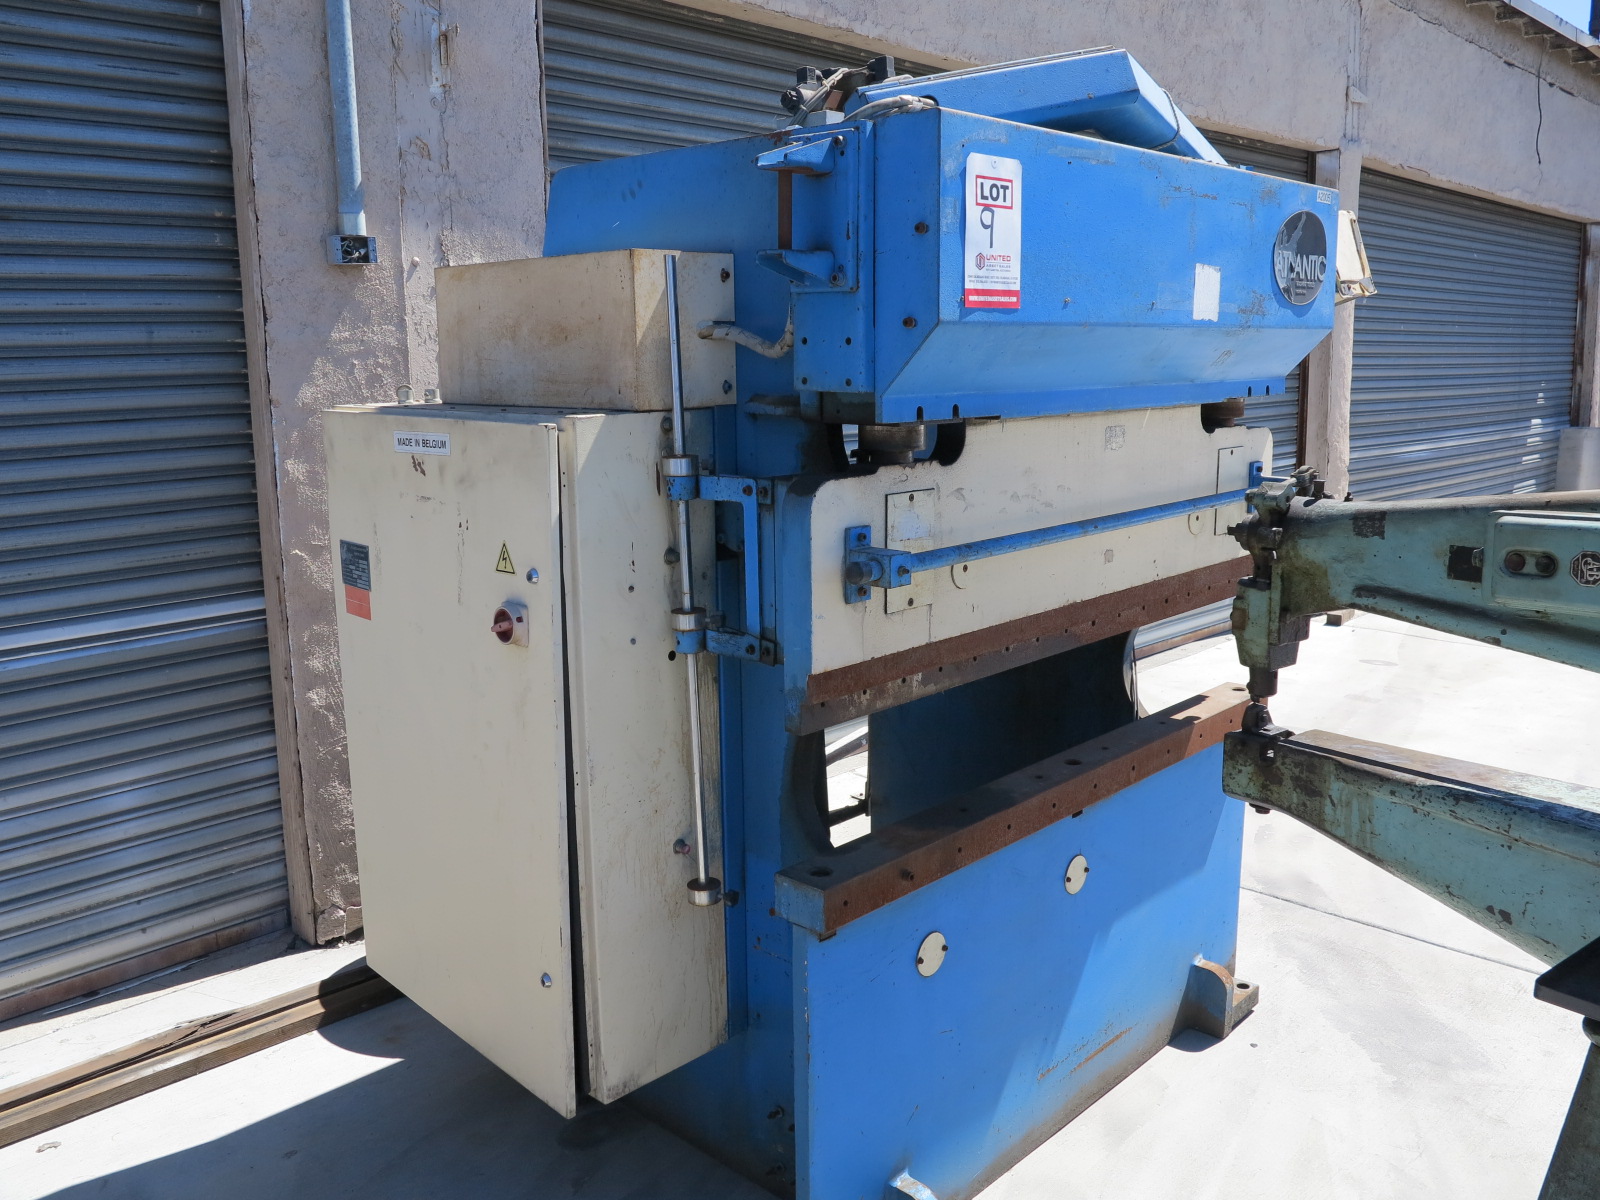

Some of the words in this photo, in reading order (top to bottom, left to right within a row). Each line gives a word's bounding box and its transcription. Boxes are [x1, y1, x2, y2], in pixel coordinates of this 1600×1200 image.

[980, 182, 1009, 202] LOT
[980, 206, 994, 248] 9
[985, 254, 1012, 262] UNITED
[397, 437, 413, 447] MADE
[414, 438, 420, 447] IN
[421, 439, 447, 449] BELGIUM
